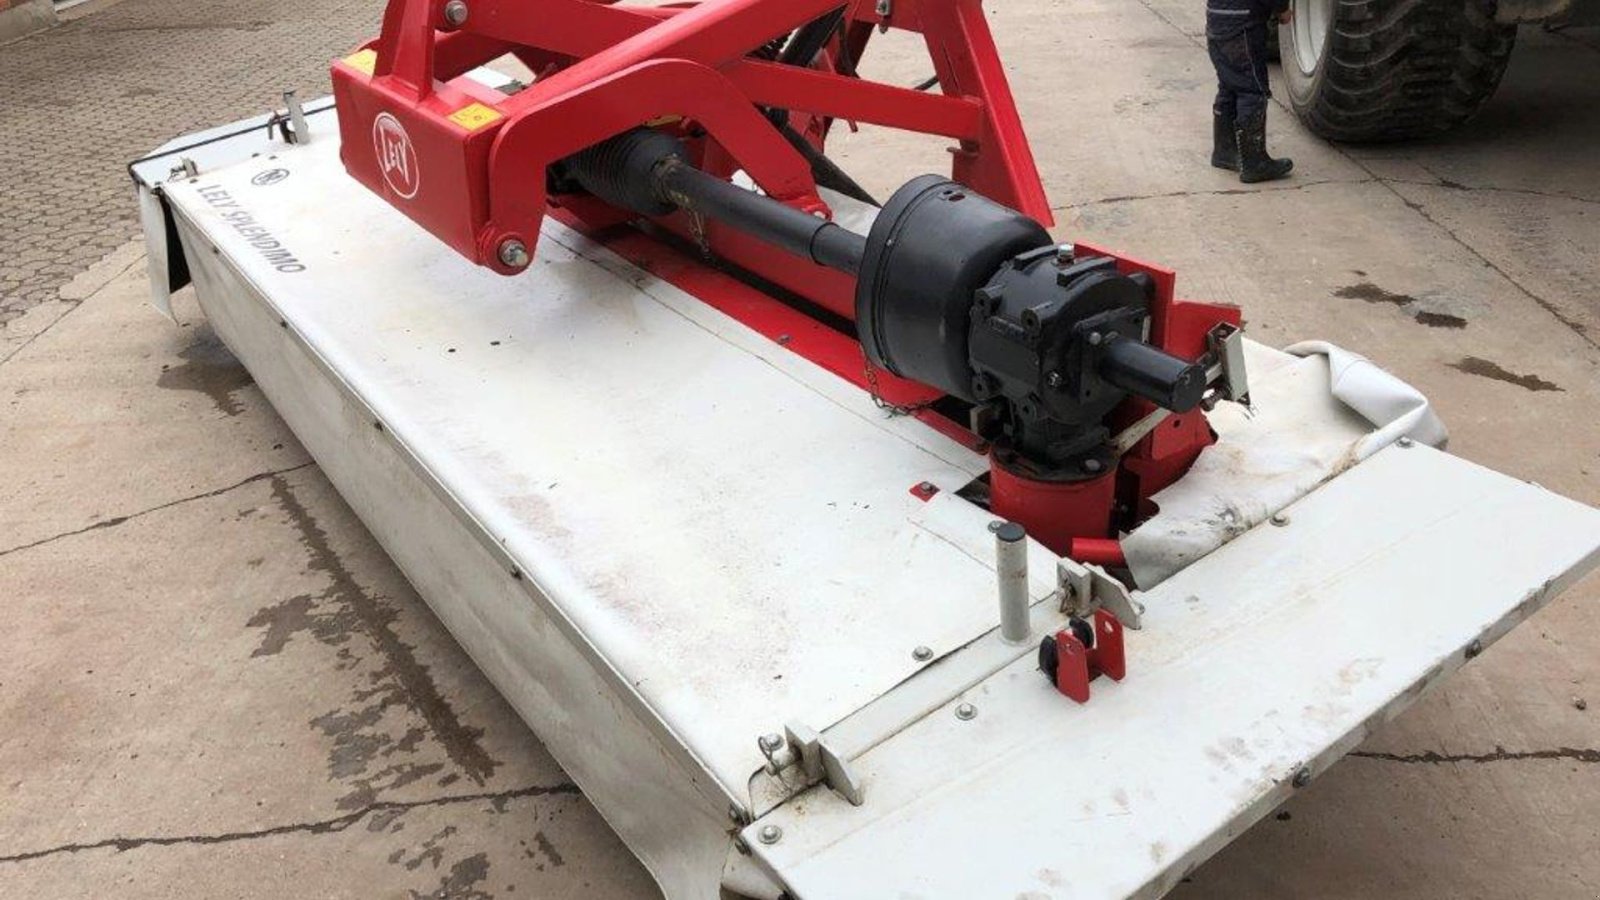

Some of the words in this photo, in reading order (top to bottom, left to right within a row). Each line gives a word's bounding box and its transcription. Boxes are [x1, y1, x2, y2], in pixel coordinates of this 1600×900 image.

[379, 122, 410, 187] LELY
[197, 184, 241, 208] LELY
[221, 210, 306, 273] SPLENDIMO
